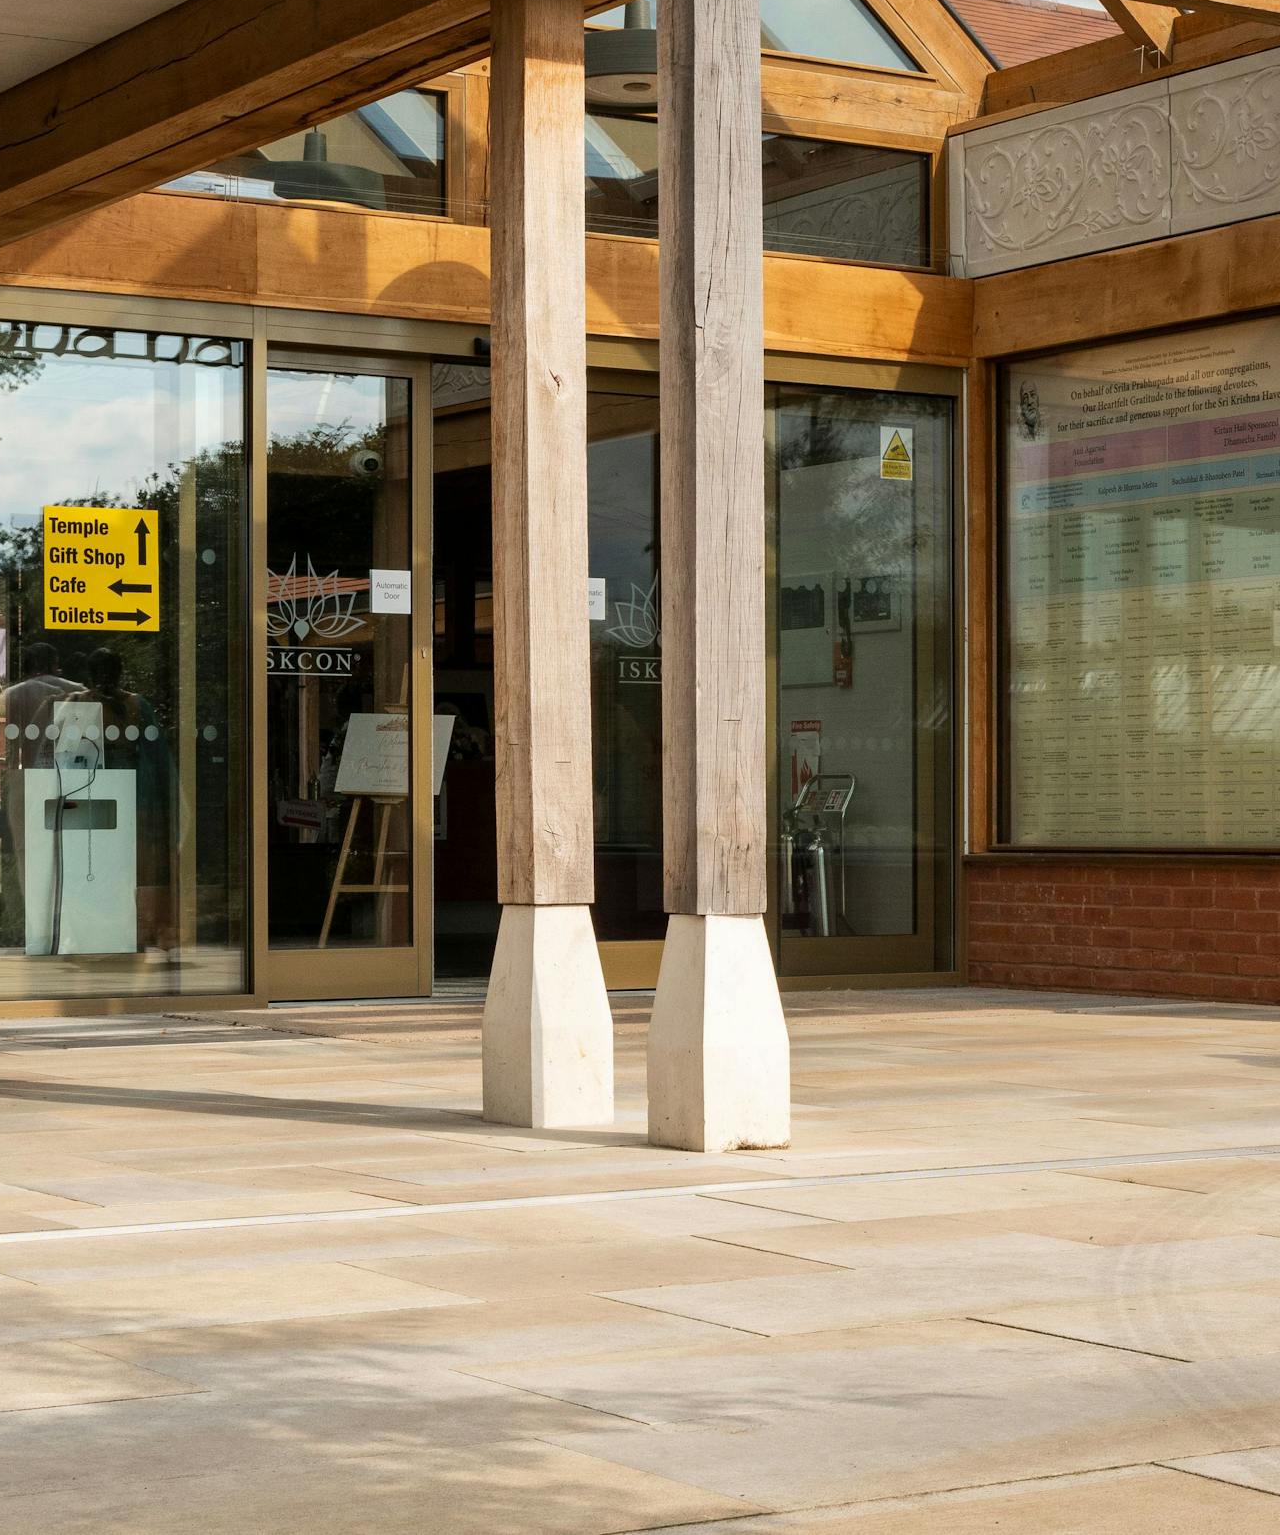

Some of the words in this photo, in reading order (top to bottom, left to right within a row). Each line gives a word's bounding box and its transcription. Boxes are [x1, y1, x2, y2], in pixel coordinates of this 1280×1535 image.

[1071, 390, 1082, 401] On
[1084, 386, 1104, 399] behalf
[1106, 384, 1114, 395] of
[1114, 382, 1130, 394] Srila
[1132, 375, 1174, 390] Prabhupada
[1176, 372, 1189, 383] and
[1191, 370, 1200, 381] all
[1202, 370, 1215, 379] our
[1216, 361, 1271, 377] congregations,
[1083, 404, 1096, 414] Our
[1098, 398, 1128, 412] Heartfelt
[1130, 392, 1164, 406] Gratitude
[1166, 392, 1173, 400] to
[1175, 388, 1186, 398] the
[1188, 382, 1222, 397] following
[1224, 379, 1258, 391] devotees,
[1058, 423, 1068, 433] for
[1070, 419, 1085, 431] their
[1086, 415, 1114, 428] sacrifice
[1116, 412, 1128, 423] and
[1130, 409, 1161, 424] generous
[1163, 404, 1192, 418] support
[1192, 401, 1203, 412] for
[1205, 399, 1217, 410] the
[1219, 396, 1229, 408] Sri
[1231, 393, 1260, 407] Krishna
[1248, 419, 1279, 431] Sponsored
[1257, 432, 1277, 443] Family
[49, 517, 109, 538] Temple
[49, 547, 78, 564] Gift
[84, 548, 125, 569] Shop
[49, 576, 86, 593] Cafe
[376, 581, 408, 590] Automatic
[384, 592, 400, 600] Door
[49, 606, 105, 624] Toilets
[267, 652, 352, 671] SKCON
[619, 662, 659, 679] ISK
